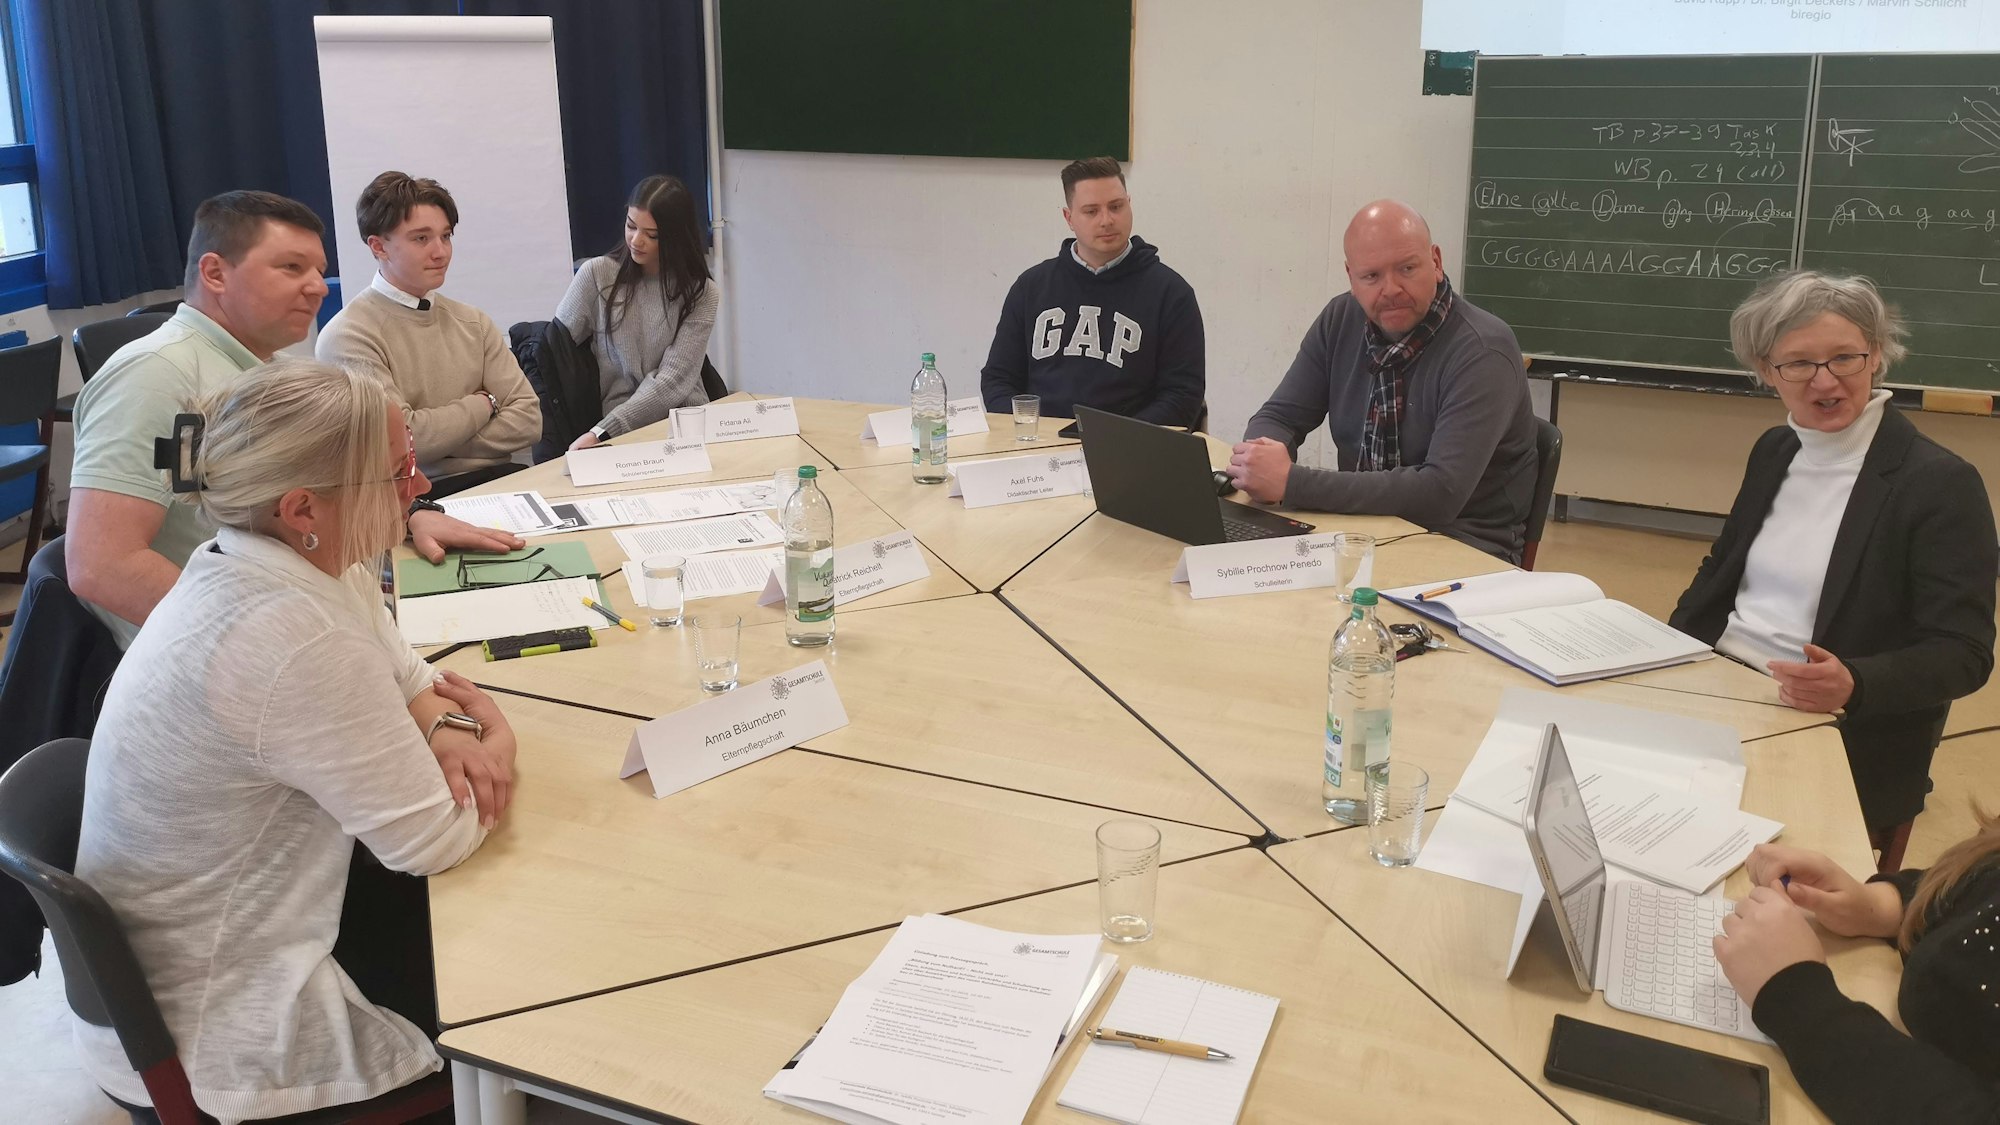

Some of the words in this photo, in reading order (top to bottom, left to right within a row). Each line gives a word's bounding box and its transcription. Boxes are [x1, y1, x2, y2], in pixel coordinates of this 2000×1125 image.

[1790, 9, 1832, 22] biregio
[1592, 122, 1625, 144] TB
[1614, 157, 1652, 181] WB
[1597, 193, 1647, 217] Dame
[1032, 305, 1142, 369] GAP
[615, 460, 642, 469] Roman
[643, 457, 665, 466] Braun
[1010, 477, 1026, 486] Axel
[1027, 475, 1045, 484] Fuhs
[1039, 486, 1054, 494] Leiter
[833, 570, 853, 584] atrick
[852, 562, 883, 578] Reichelt
[1216, 567, 1245, 579] Sybille
[1247, 563, 1288, 574] Prochnow
[1290, 558, 1322, 569] Penedo
[838, 578, 885, 598] Elternpflegschaft
[1254, 577, 1293, 589] Schulleiterin
[704, 729, 733, 748] Anna
[733, 708, 787, 736] Bäumchen
[721, 730, 786, 762] Elternpflegschaft
